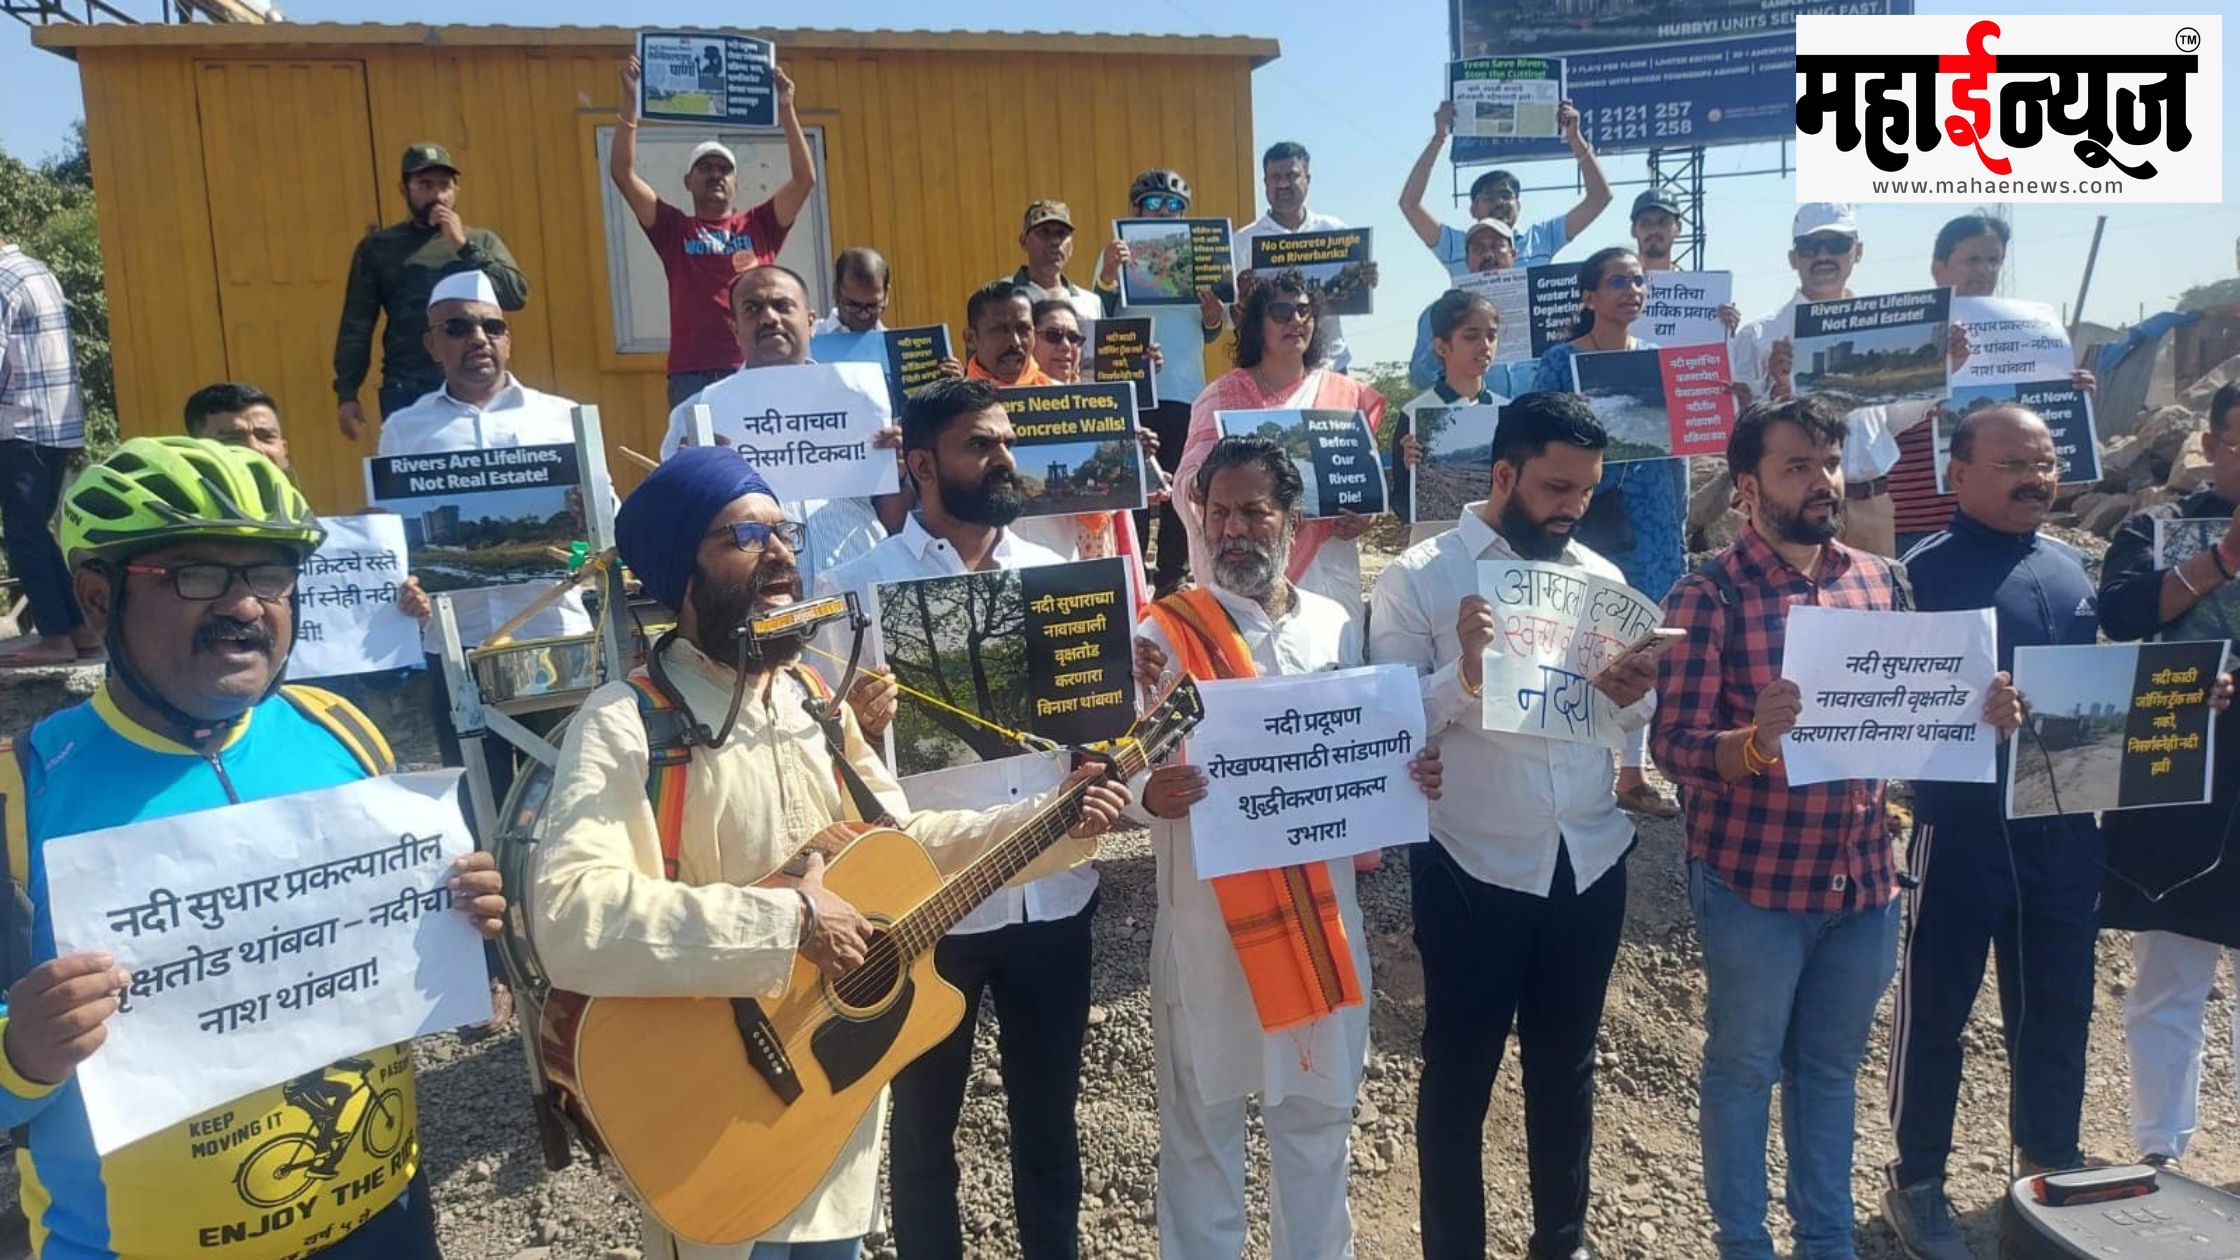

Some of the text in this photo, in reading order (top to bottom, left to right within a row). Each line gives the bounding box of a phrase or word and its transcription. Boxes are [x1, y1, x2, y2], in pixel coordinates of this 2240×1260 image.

[1722, 15, 1767, 31] UNITS
[1464, 61, 1490, 69] Trees
[1492, 59, 1515, 68] Save
[1601, 105, 1647, 123] 2121
[1655, 101, 1692, 119] 257
[1601, 123, 1647, 140] 2121
[1655, 119, 1691, 136] 258
[1261, 234, 1360, 251] No Concrete Jungle
[1271, 248, 1348, 263] on Riverbanks!
[1537, 274, 1578, 289] Ground
[1674, 283, 1705, 300] तिचा
[1537, 290, 1569, 303] water
[1810, 292, 1936, 317] Rivers Are Lifelines,
[1684, 306, 1717, 321] प्रवाह
[1822, 307, 1924, 331] Not Real Estate!
[1005, 393, 1118, 413] ers Need Trees,
[2021, 392, 2039, 405] Act
[744, 408, 847, 435] नदी वाचवा
[1080, 417, 1125, 433] Walls!
[1309, 420, 1360, 432] Act Now,
[2051, 427, 2066, 437] ur
[798, 441, 866, 465] टिकवा!
[1319, 436, 1358, 448] Before
[2057, 445, 2076, 455] ers
[391, 447, 562, 474] Rivers Are Lifelines,
[1332, 454, 1355, 465] Our
[410, 467, 549, 492] Not Real Estate!
[1329, 472, 1366, 485] Rivers
[1339, 491, 1362, 504] Die!
[365, 550, 398, 571] रस्ते
[318, 584, 361, 609] स्नेही
[365, 581, 398, 603] नदी
[1031, 591, 1115, 615] नदी सुधाराच्या
[1043, 613, 1107, 637] नावाखाली
[1054, 641, 1100, 666] वृक्षतोड
[1846, 650, 1963, 680] नदी सुधाराच्या
[1055, 668, 1104, 687] करणारा
[2152, 668, 2171, 685] नदी
[1037, 689, 1123, 717] विनाश थांबवा!
[1816, 684, 1970, 713] नावाखाली वृक्षतोड
[1264, 706, 1362, 736] नदी प्रदूषण
[1791, 719, 1976, 744] करणारा विनाश थांबवा!
[2179, 733, 2199, 750] नदी
[1208, 730, 1412, 779] रोखण्यासाठी सांडपाणी
[1238, 775, 1387, 820] शुद्धीकरण प्रकल्प
[1286, 818, 1347, 846] उभारा!
[107, 832, 444, 938] नदी सुधार प्रकल्पातील
[118, 945, 233, 1014] ृक्षतोड
[238, 915, 341, 966] थांबवा
[369, 886, 453, 928] नदीचा
[198, 957, 381, 1035] नाश थांबवा!
[189, 1111, 235, 1137] KEEP
[191, 1111, 283, 1159] MOVING IT
[199, 1196, 318, 1248] ENJOY
[332, 1166, 385, 1206] THE
